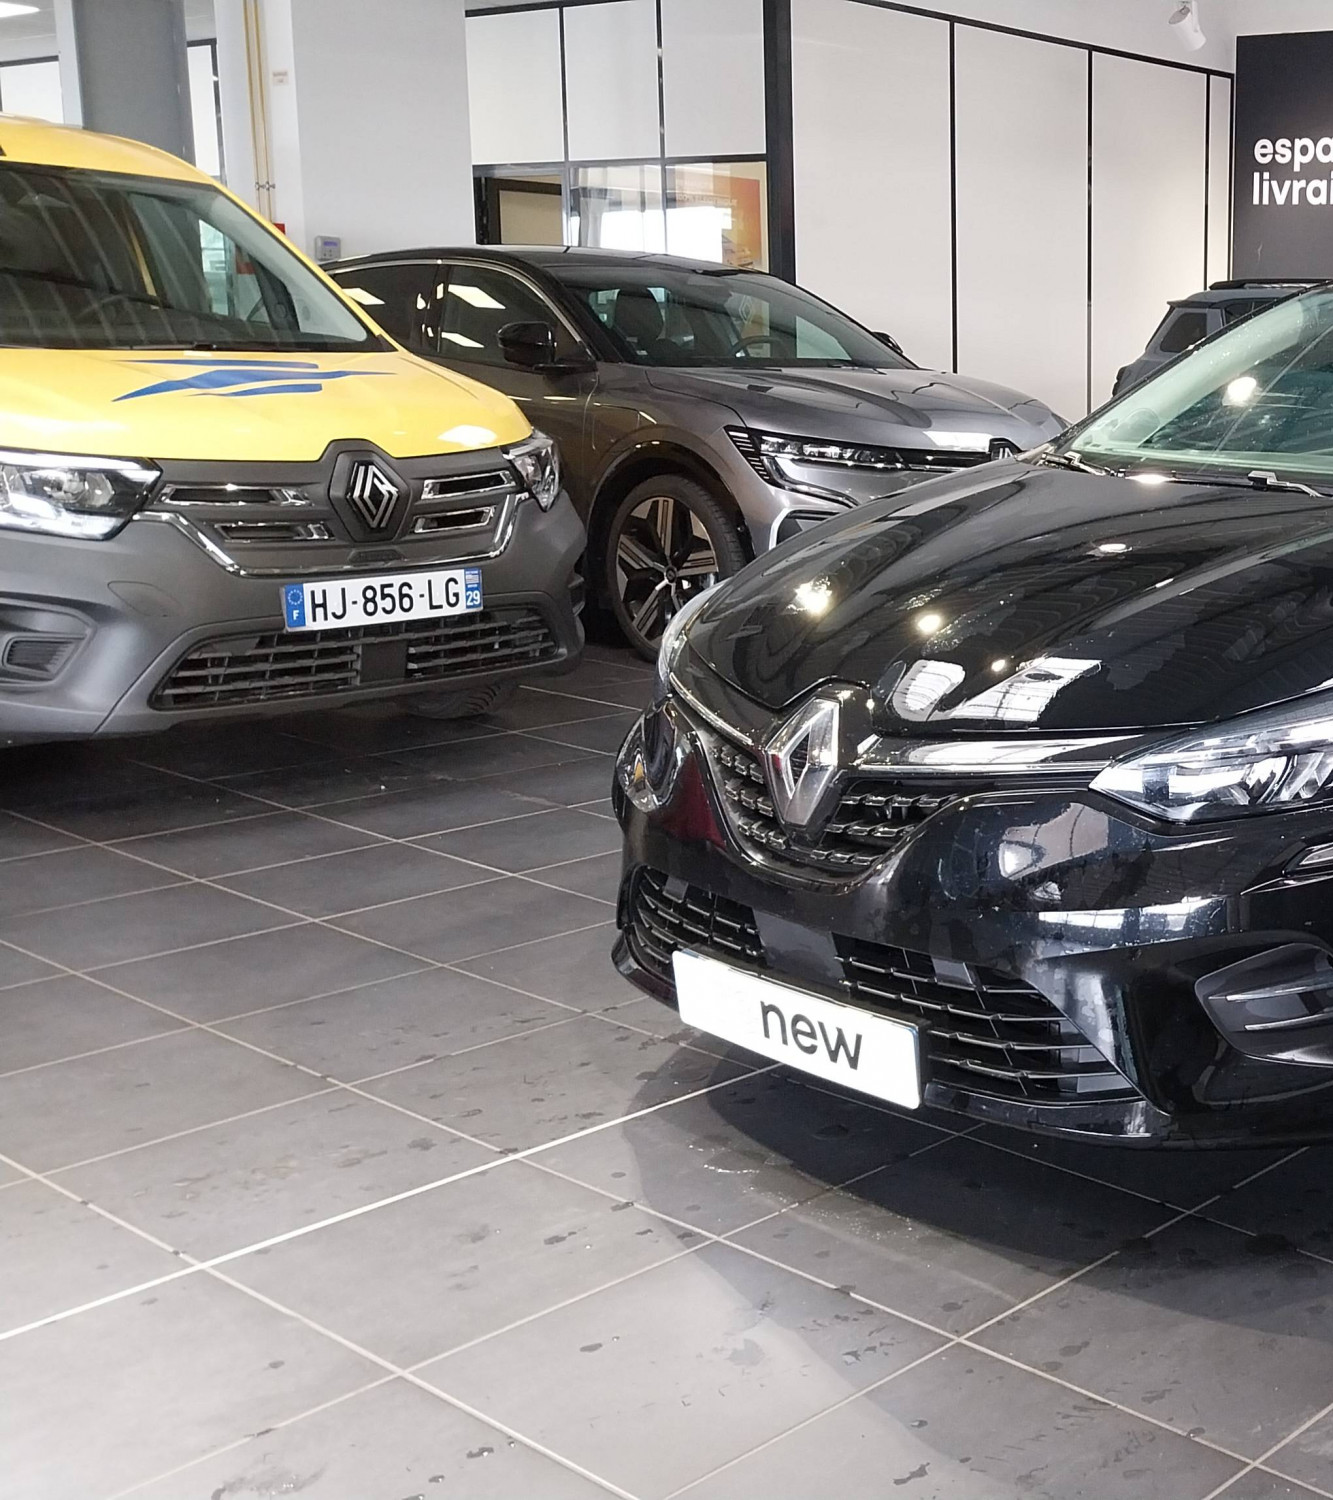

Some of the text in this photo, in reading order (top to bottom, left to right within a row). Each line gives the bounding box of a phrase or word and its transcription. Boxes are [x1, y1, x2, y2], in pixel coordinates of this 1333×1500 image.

[310, 577, 460, 622] HJ-856-LG
[466, 591, 481, 606] 29
[293, 610, 300, 621] F
[760, 1000, 863, 1071] new
